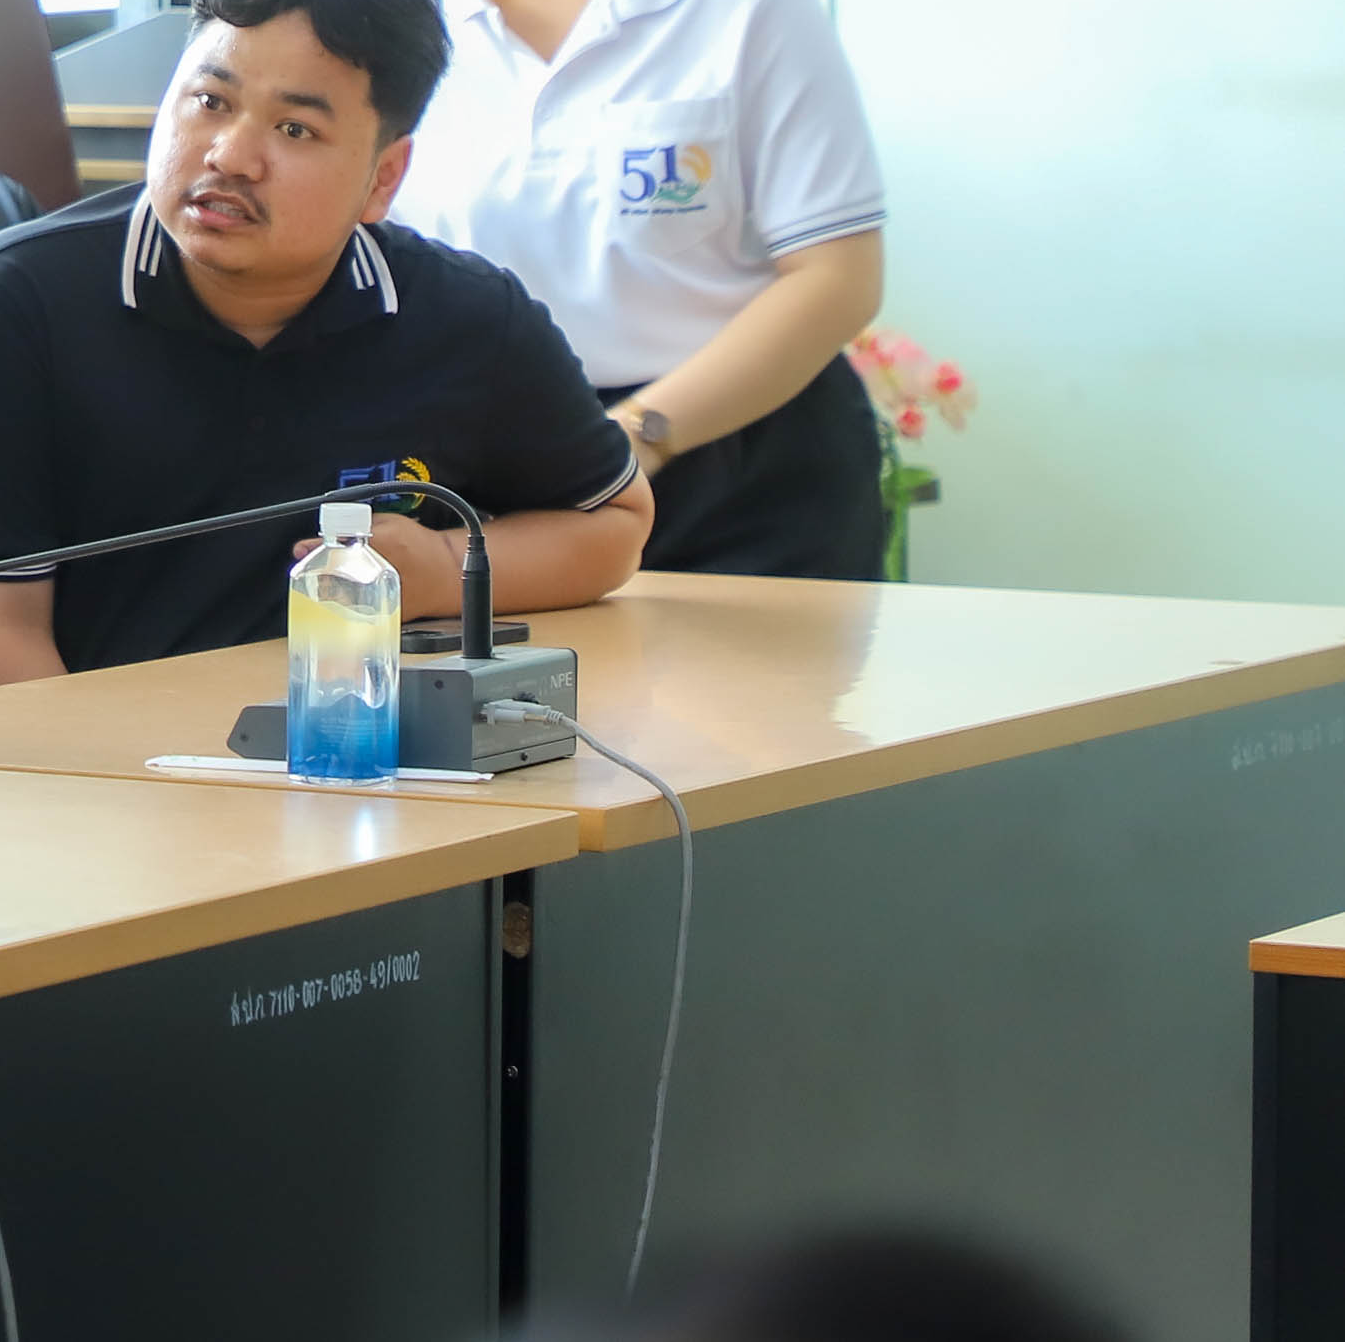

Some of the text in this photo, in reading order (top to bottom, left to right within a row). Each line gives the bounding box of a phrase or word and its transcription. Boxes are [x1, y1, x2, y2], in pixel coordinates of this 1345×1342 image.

[620, 144, 682, 203] 51
[550, 671, 574, 689] NPE
[268, 951, 421, 1017] 7110-007-0058-49/0002
